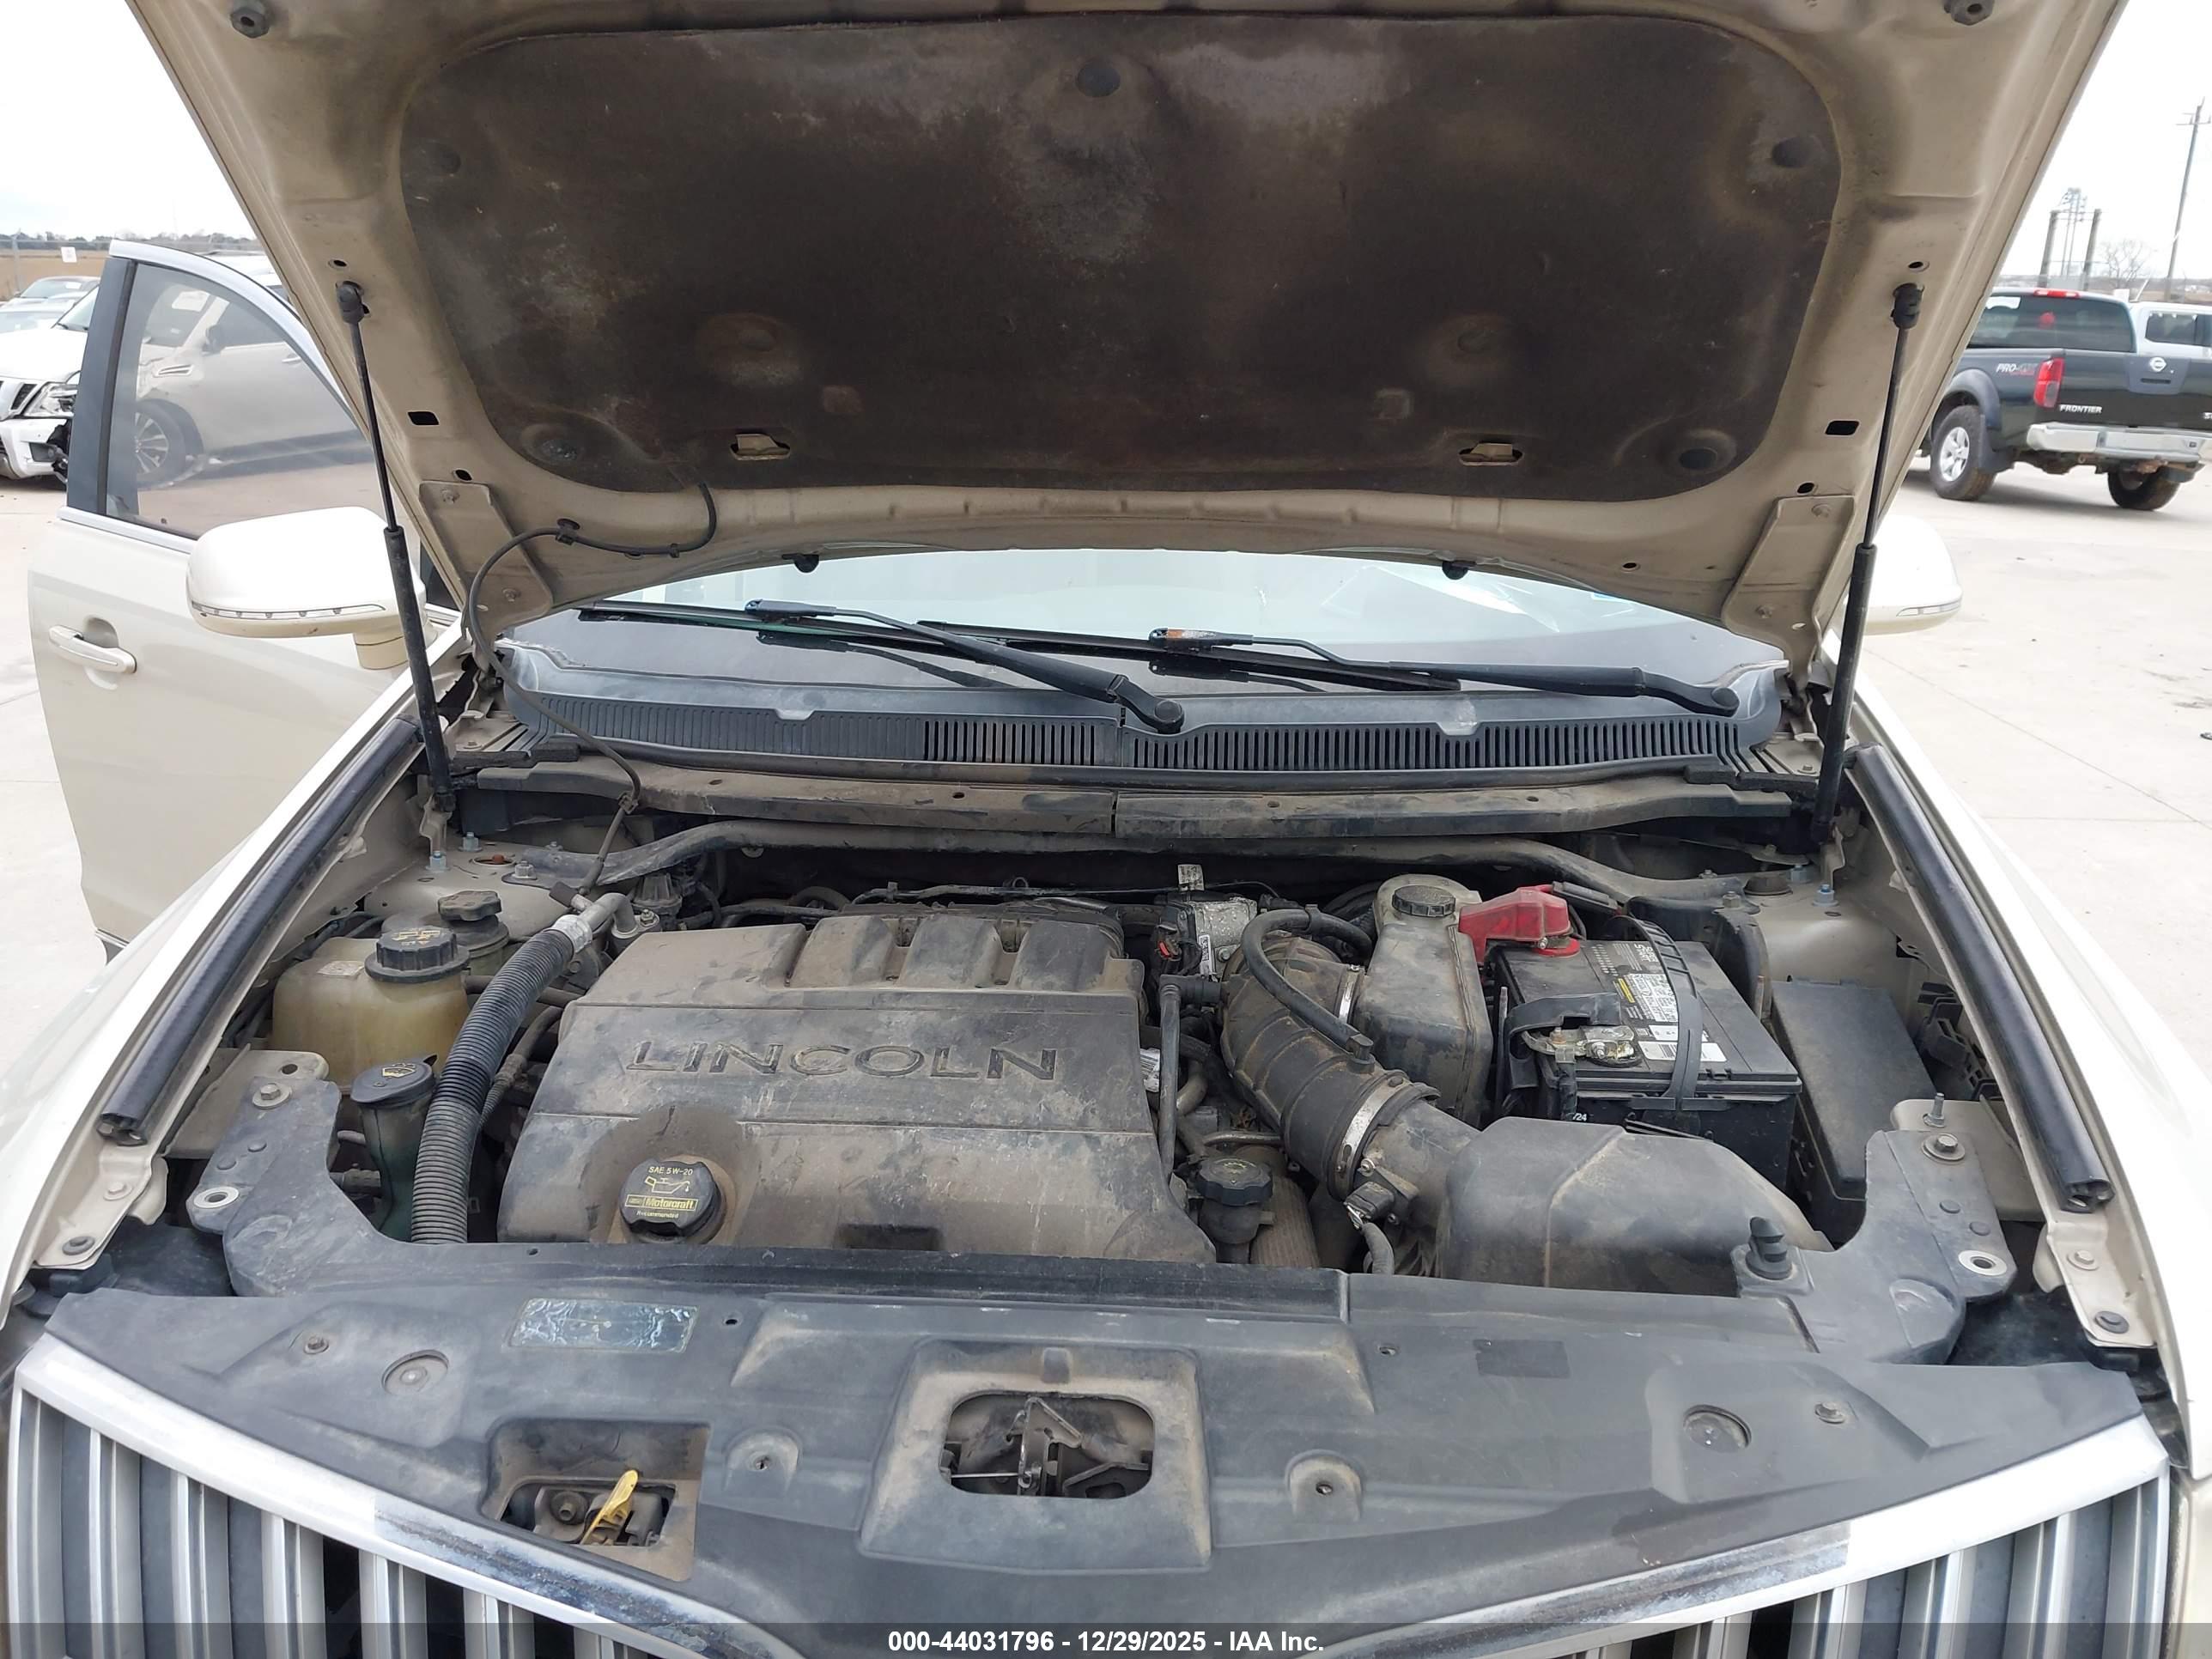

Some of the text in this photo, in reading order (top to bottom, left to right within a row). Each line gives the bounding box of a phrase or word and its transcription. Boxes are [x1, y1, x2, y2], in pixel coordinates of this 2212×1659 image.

[2059, 404, 2103, 414] FRONTIER
[1633, 943, 1650, 962] START
[625, 1040, 1059, 1081] LINCOLN
[647, 1166, 665, 1175] SAE
[645, 1197, 695, 1210] Motorcraft
[636, 1210, 679, 1219] Recommended
